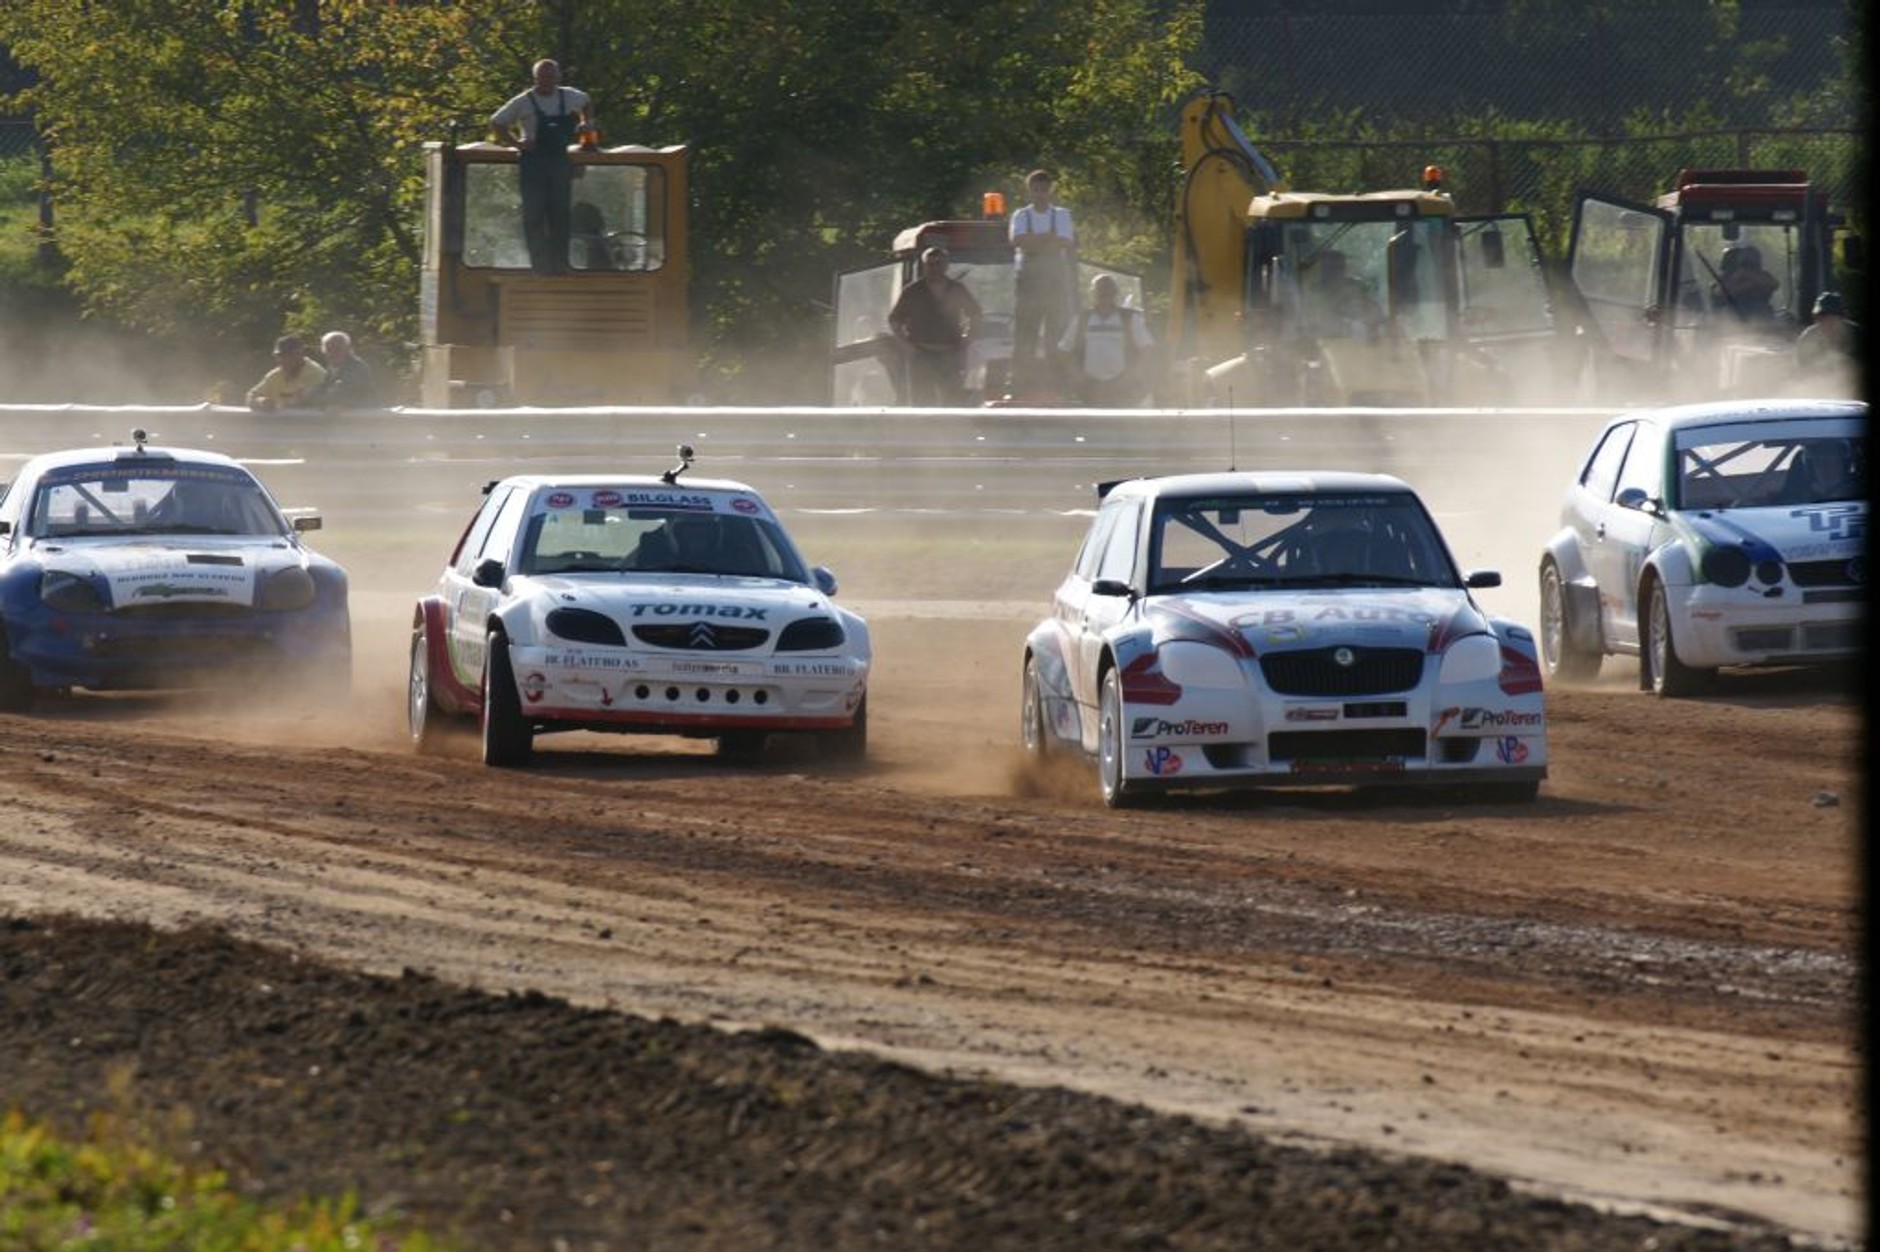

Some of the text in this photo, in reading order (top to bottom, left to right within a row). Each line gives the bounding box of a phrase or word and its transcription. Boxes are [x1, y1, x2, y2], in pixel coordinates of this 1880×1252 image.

[628, 493, 712, 505] BILGLASS
[1228, 609, 1296, 628] CB
[1481, 709, 1542, 725] ProTeren
[1157, 719, 1229, 735] ProTeren
